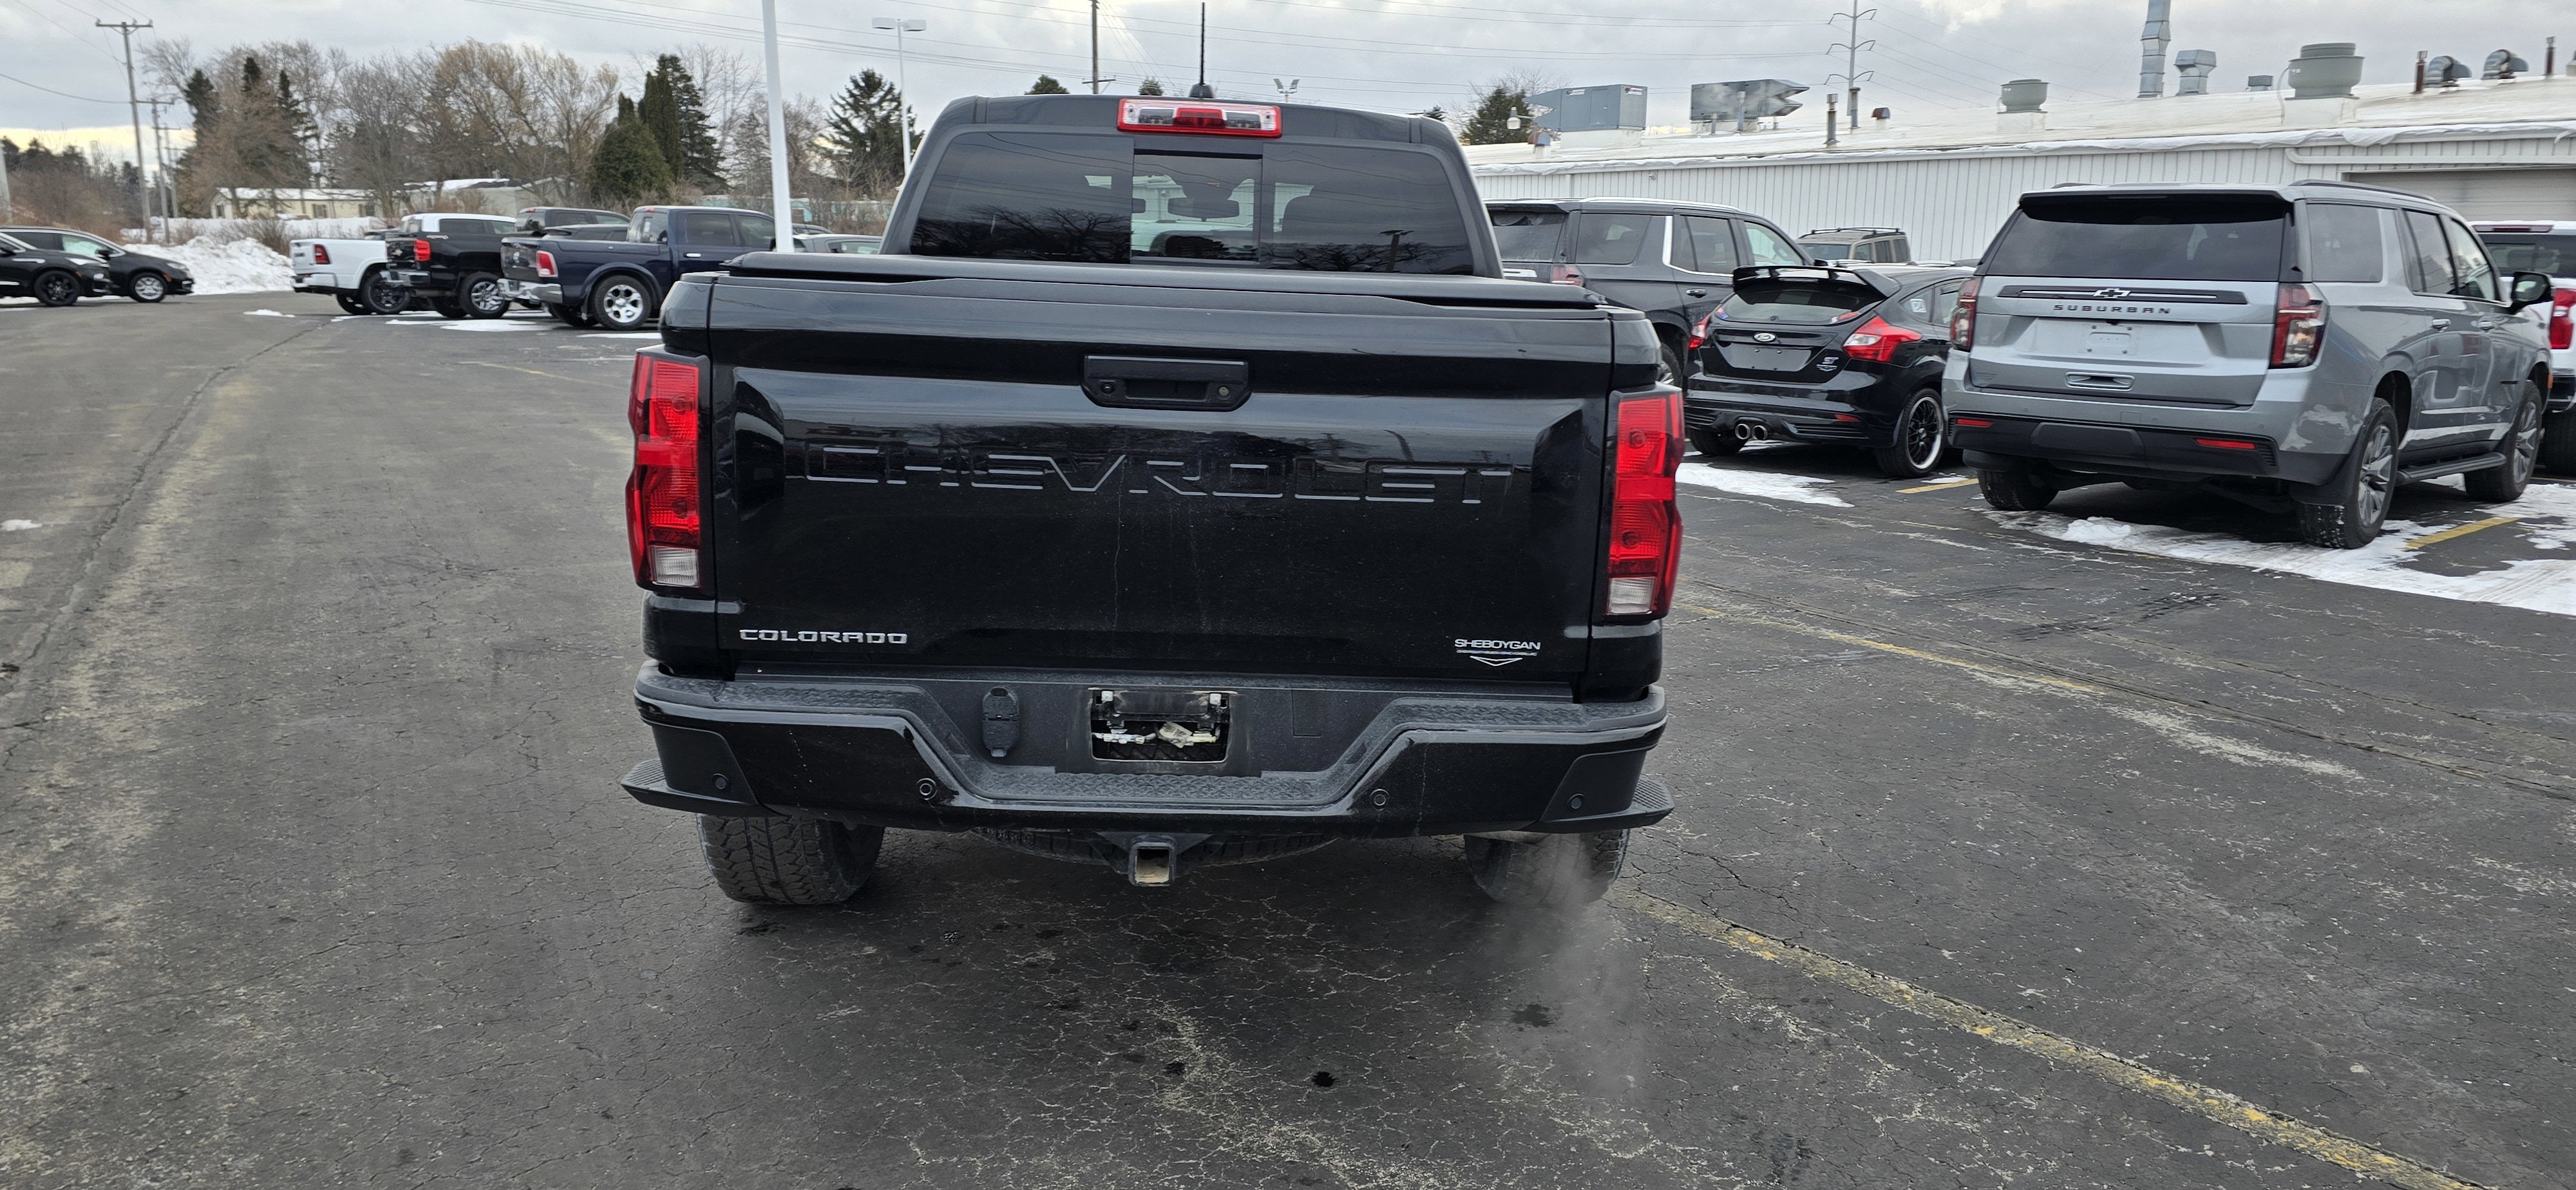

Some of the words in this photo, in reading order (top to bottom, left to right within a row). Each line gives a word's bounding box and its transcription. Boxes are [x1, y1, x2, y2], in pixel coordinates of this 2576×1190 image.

[2053, 305, 2172, 314] SUBURBAN
[804, 443, 1513, 505] CHEVROLET
[739, 629, 907, 644] COLORADO
[1454, 639, 1541, 650] SHEBOYGAN
